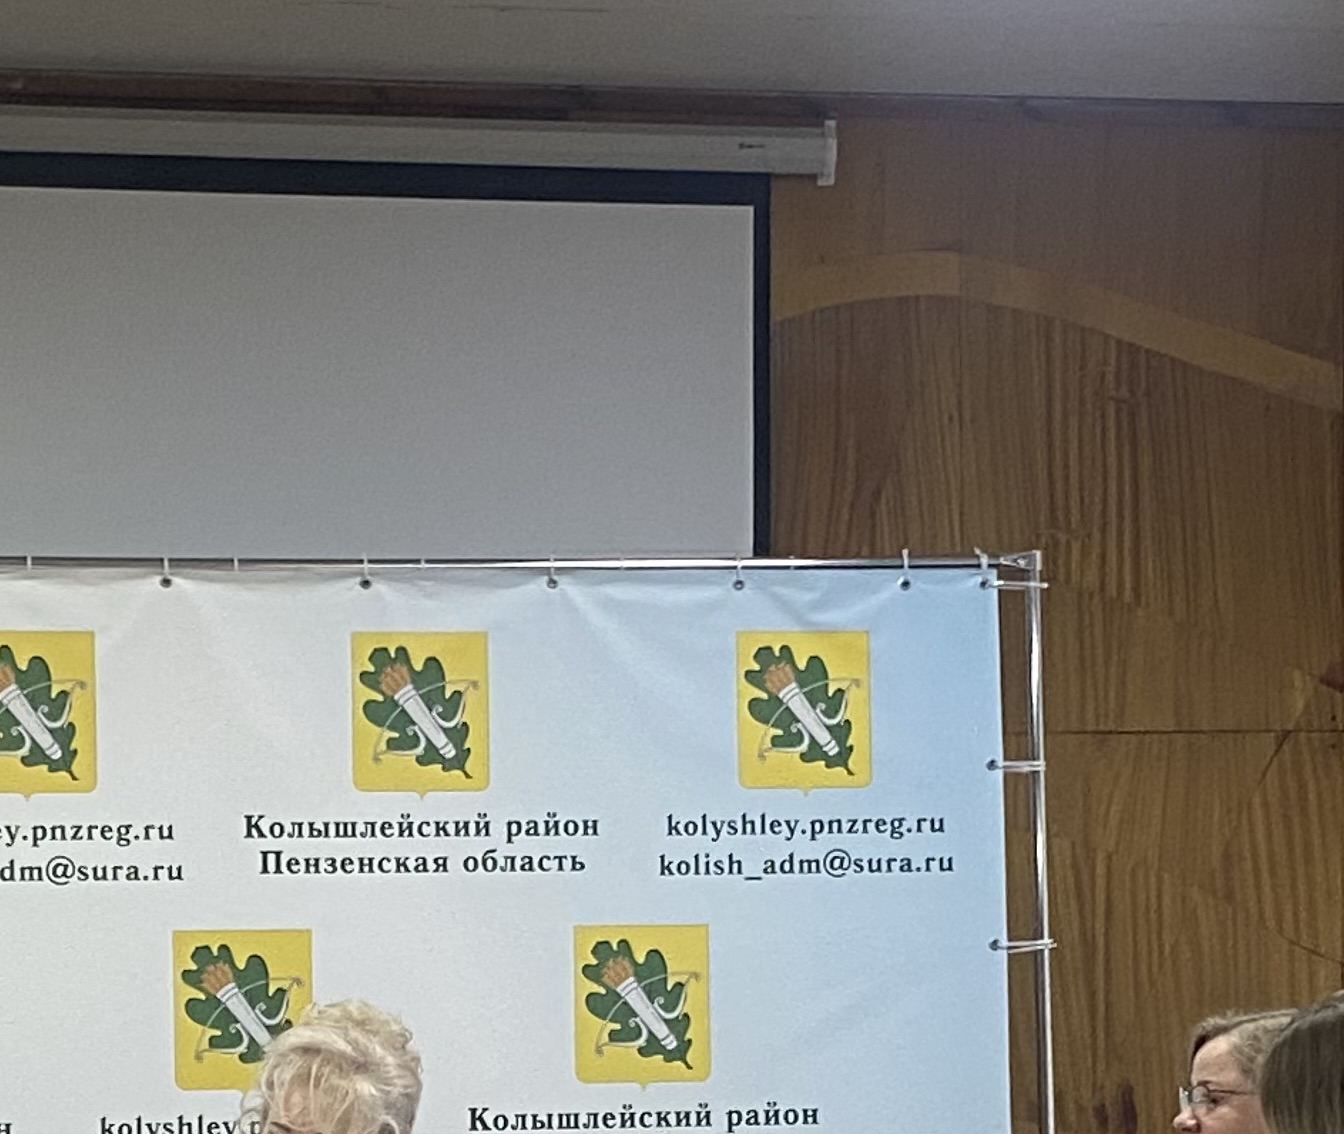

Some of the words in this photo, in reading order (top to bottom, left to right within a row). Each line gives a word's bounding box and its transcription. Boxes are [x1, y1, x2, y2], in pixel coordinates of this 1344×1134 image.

[243, 812, 491, 839] Колышлейский
[506, 811, 599, 844] район
[665, 812, 946, 843] kolyshley.pnzreg.ru
[259, 850, 449, 874] Пензенская
[462, 848, 586, 873] область
[658, 848, 955, 881] kolish_adm@sura.ru
[467, 1102, 712, 1132] Колышлейский
[725, 1101, 820, 1134] район
